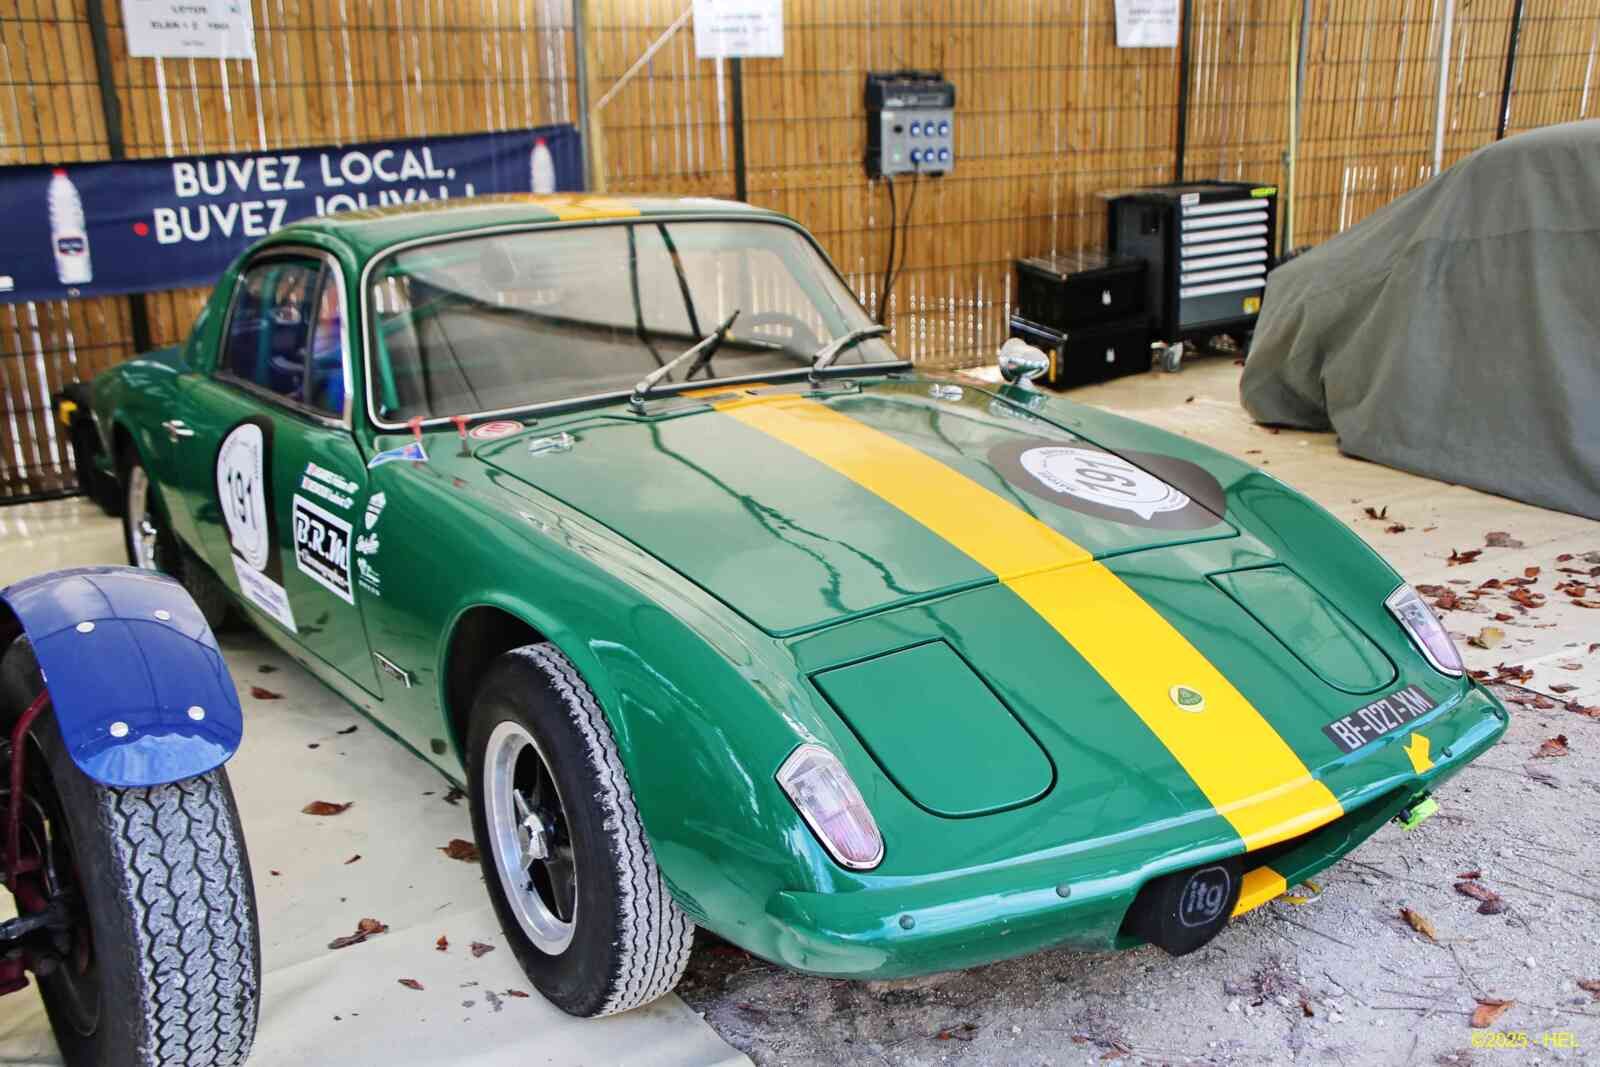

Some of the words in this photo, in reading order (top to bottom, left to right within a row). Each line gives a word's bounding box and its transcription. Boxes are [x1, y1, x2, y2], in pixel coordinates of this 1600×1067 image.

[173, 155, 305, 197] BUVEZ
[153, 198, 287, 244] BUVEZ
[1330, 687, 1433, 750] BF-027-XM
[1187, 880, 1224, 915] itg
